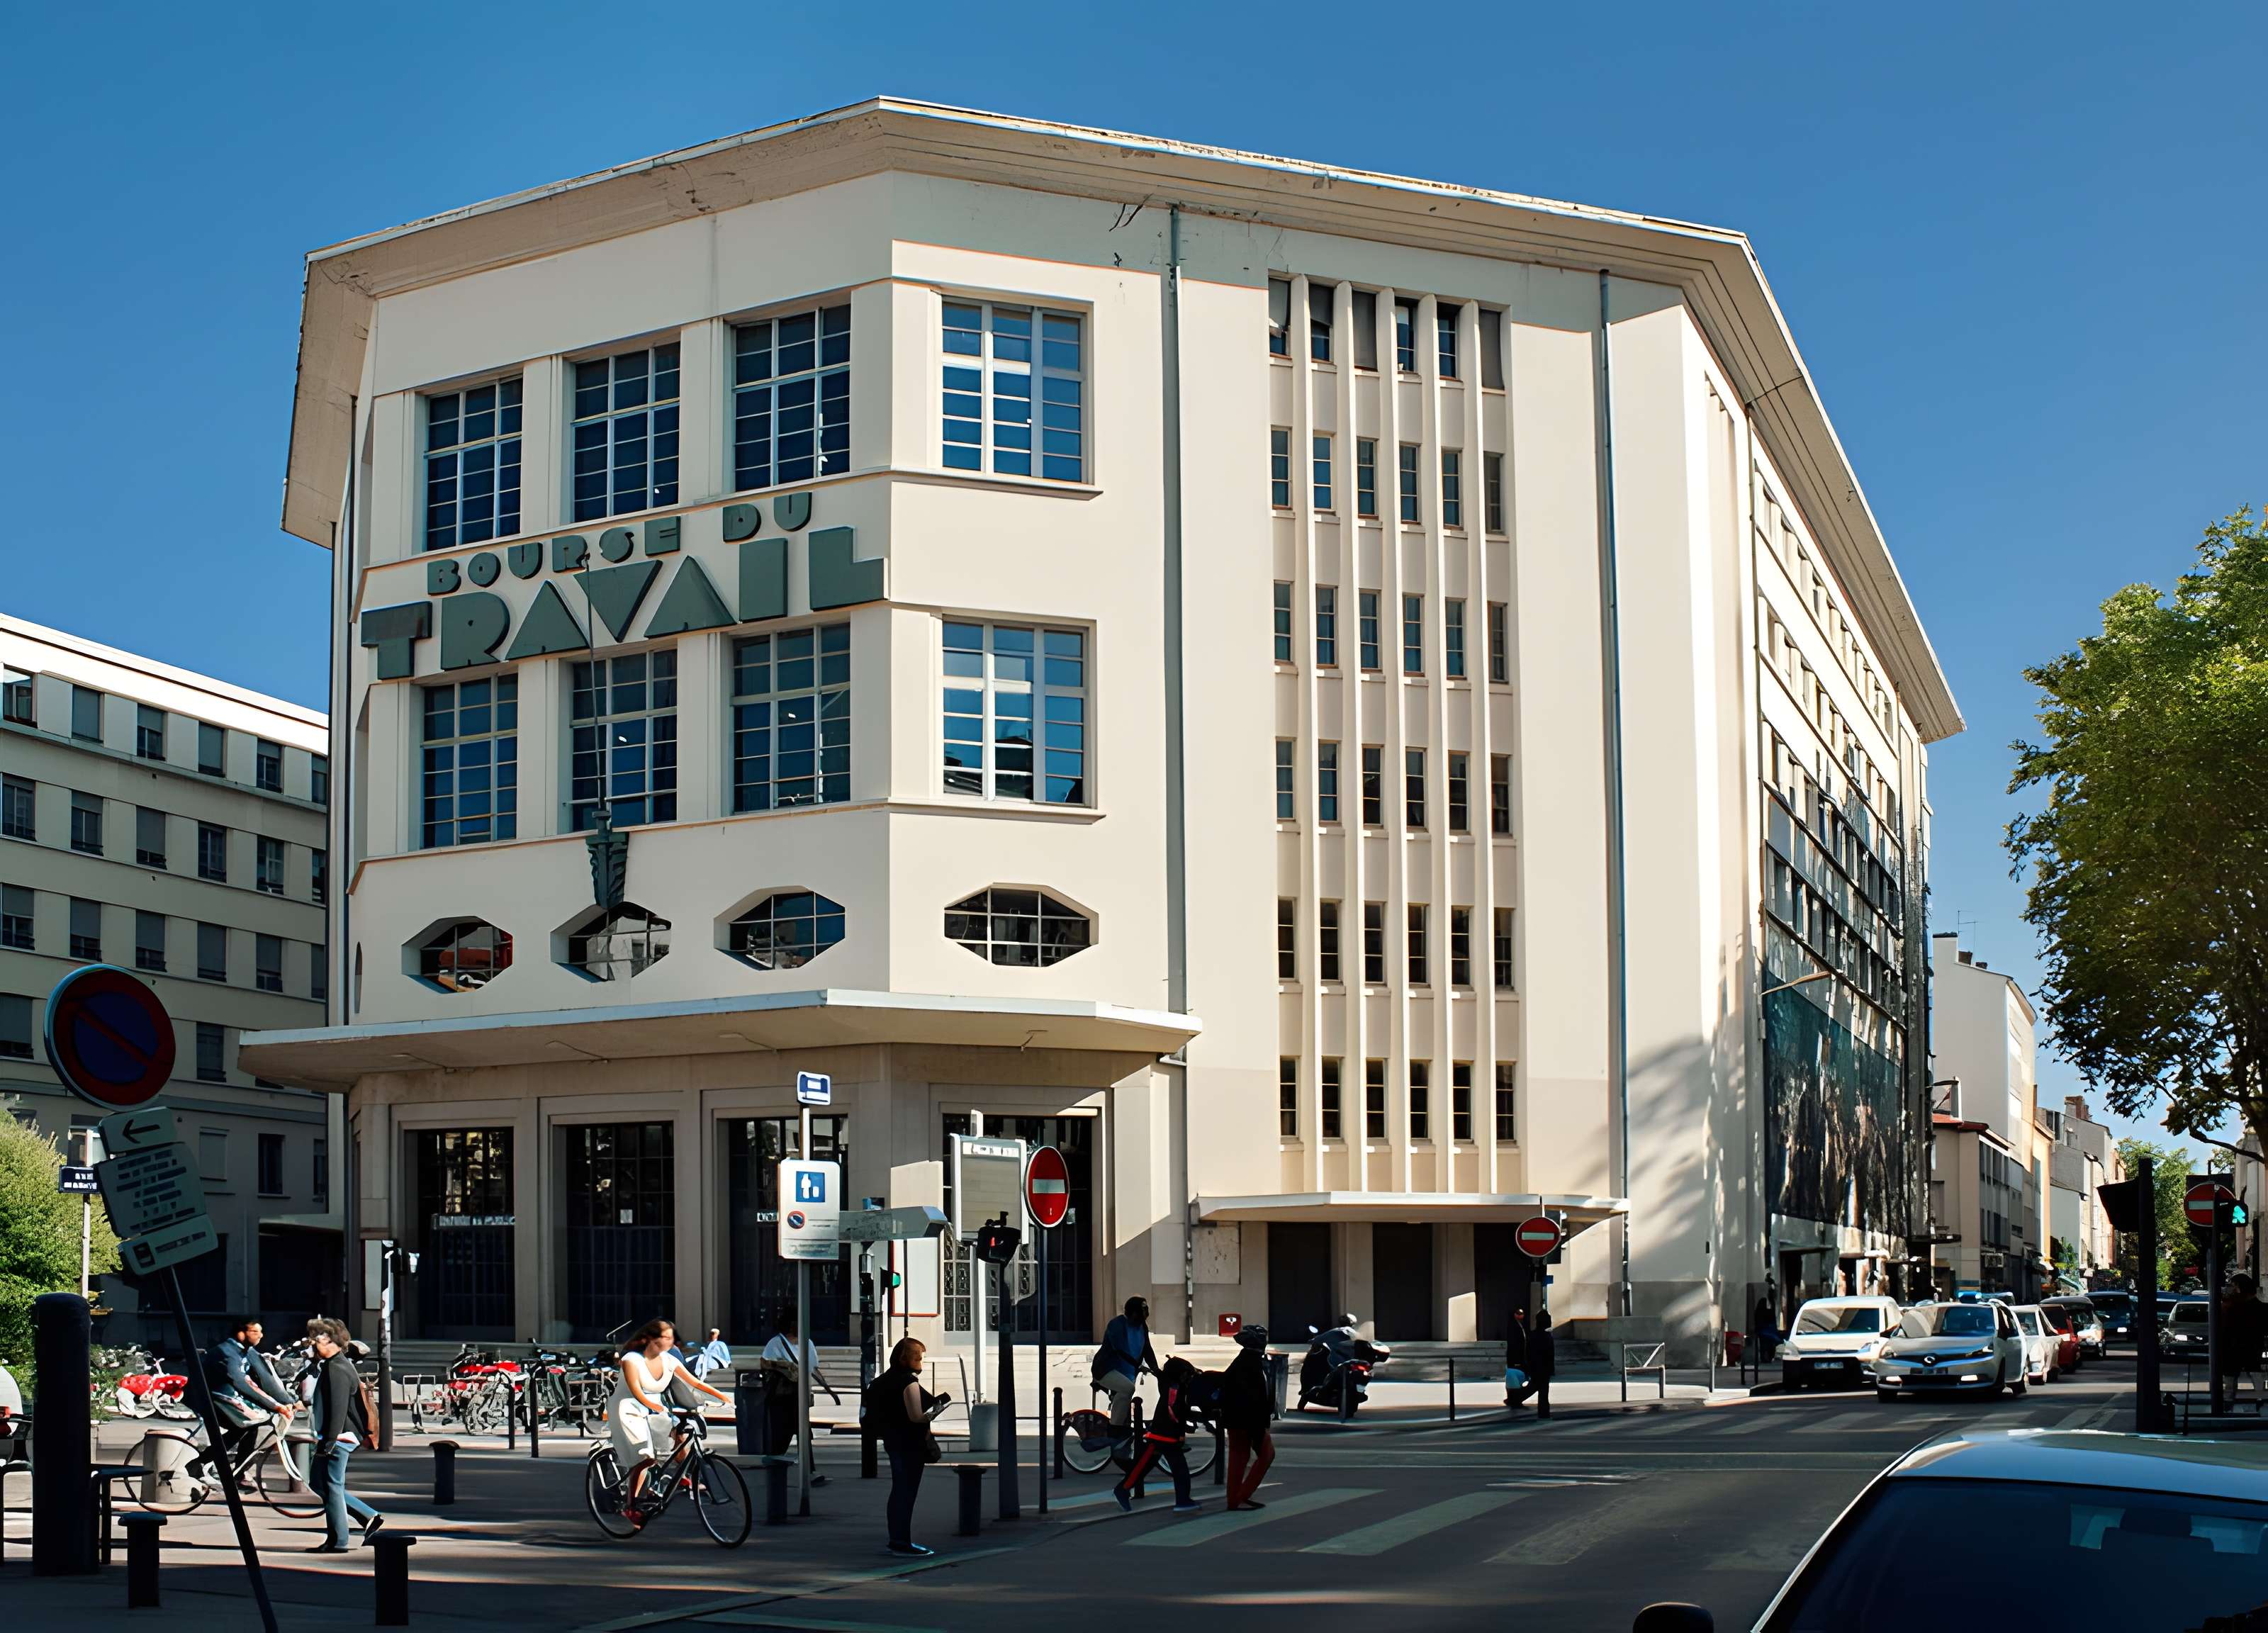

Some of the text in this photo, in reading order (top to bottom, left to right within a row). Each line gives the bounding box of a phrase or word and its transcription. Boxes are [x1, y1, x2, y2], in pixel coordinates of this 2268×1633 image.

[361, 527, 887, 680] TRAVAIL
[428, 492, 812, 595] BOURSE DU
